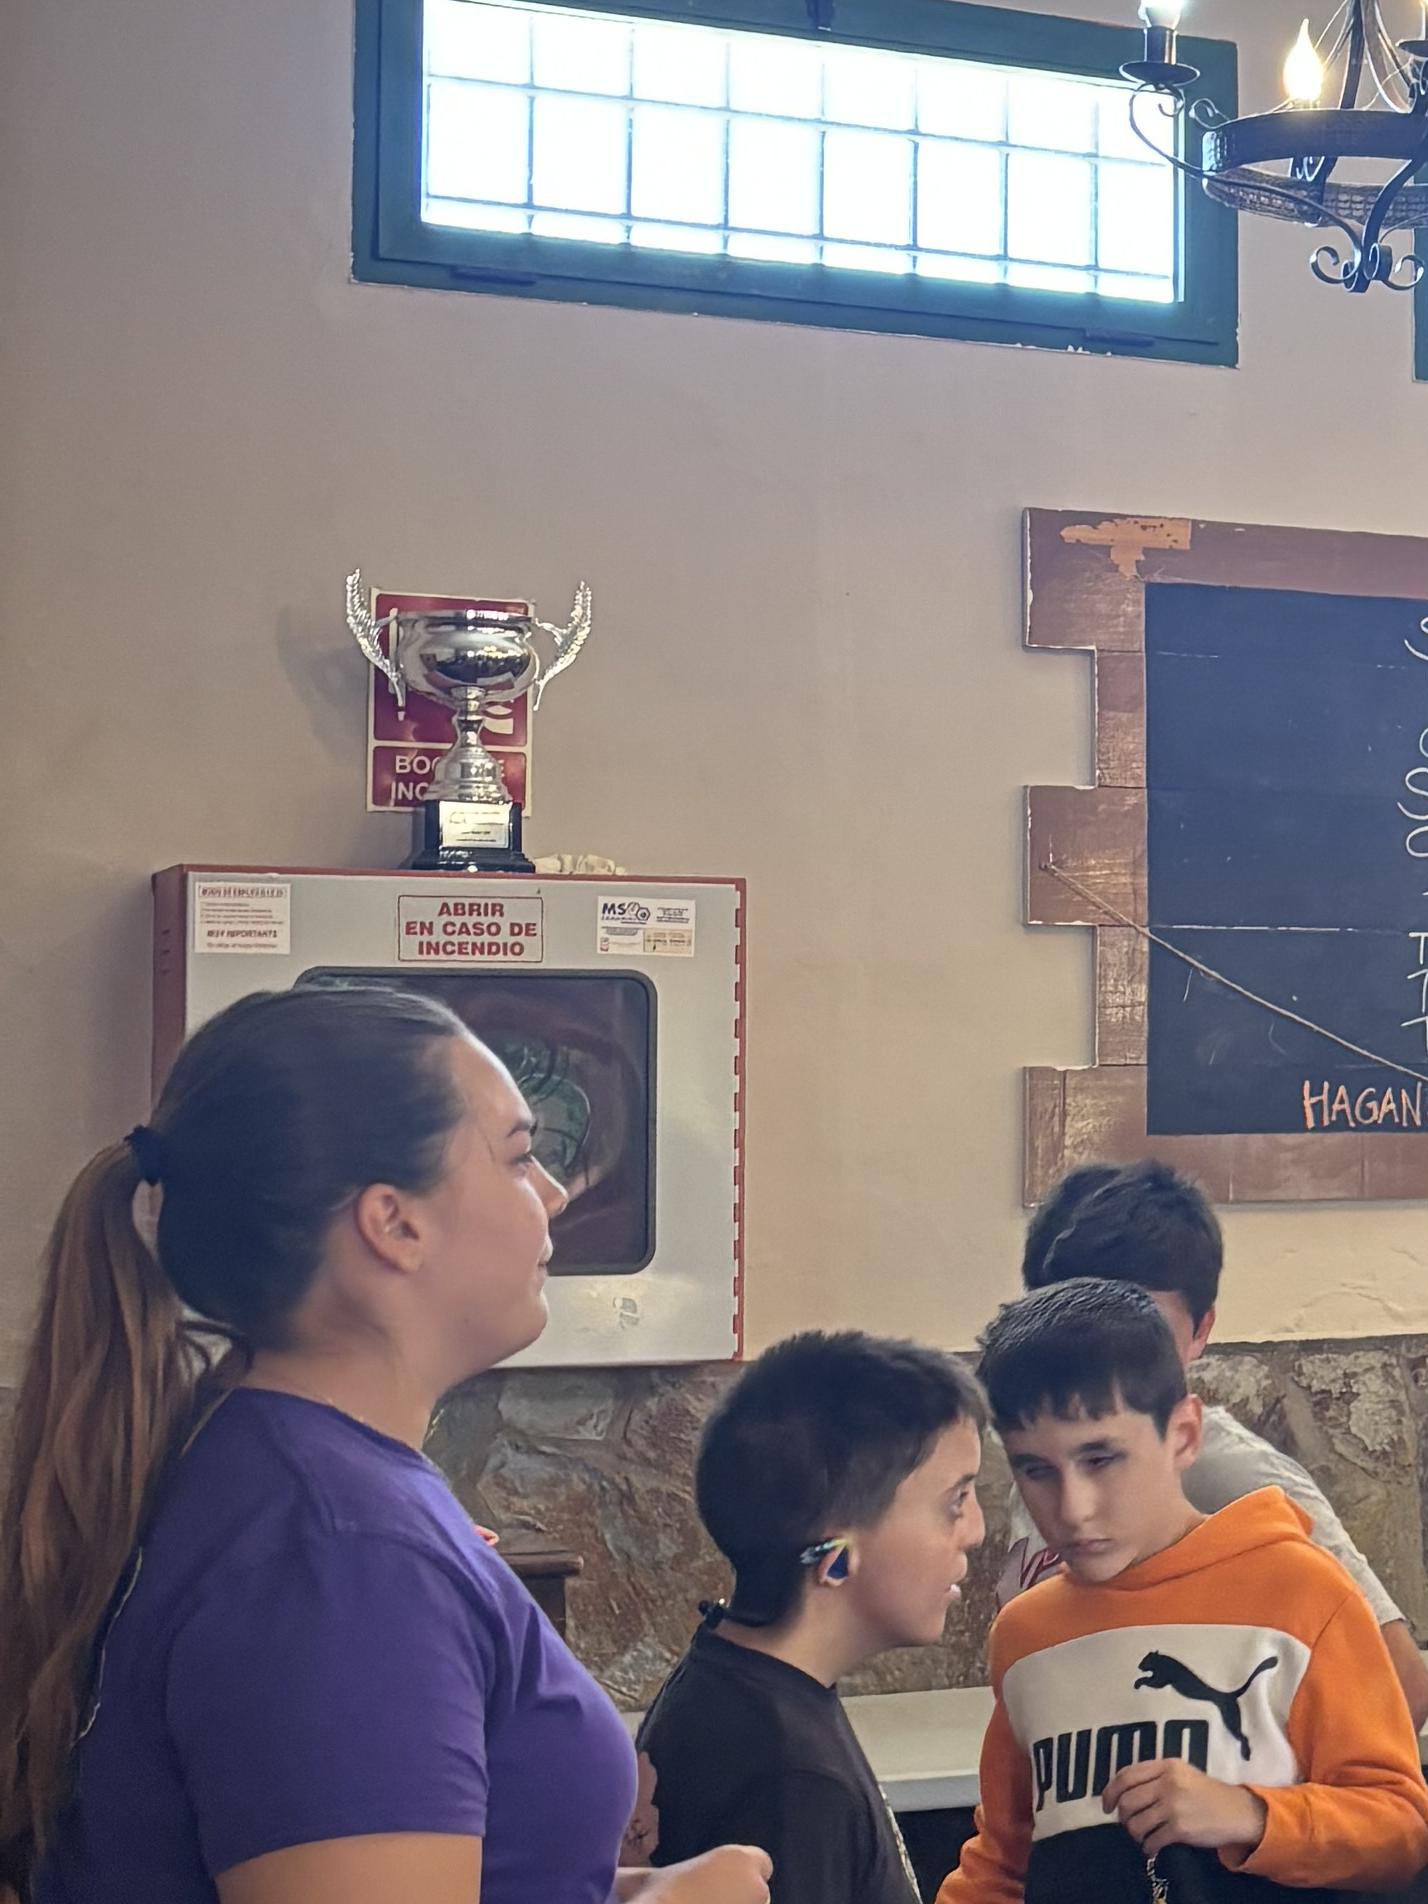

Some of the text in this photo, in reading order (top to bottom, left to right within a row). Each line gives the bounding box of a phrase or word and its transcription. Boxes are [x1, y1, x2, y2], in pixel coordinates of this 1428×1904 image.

[395, 755, 441, 774] BO
[438, 902, 505, 918] ABRIR
[404, 921, 538, 938] EN CASO DE
[417, 941, 526, 957] INCENDIO
[1303, 1080, 1424, 1130] HAGAN
